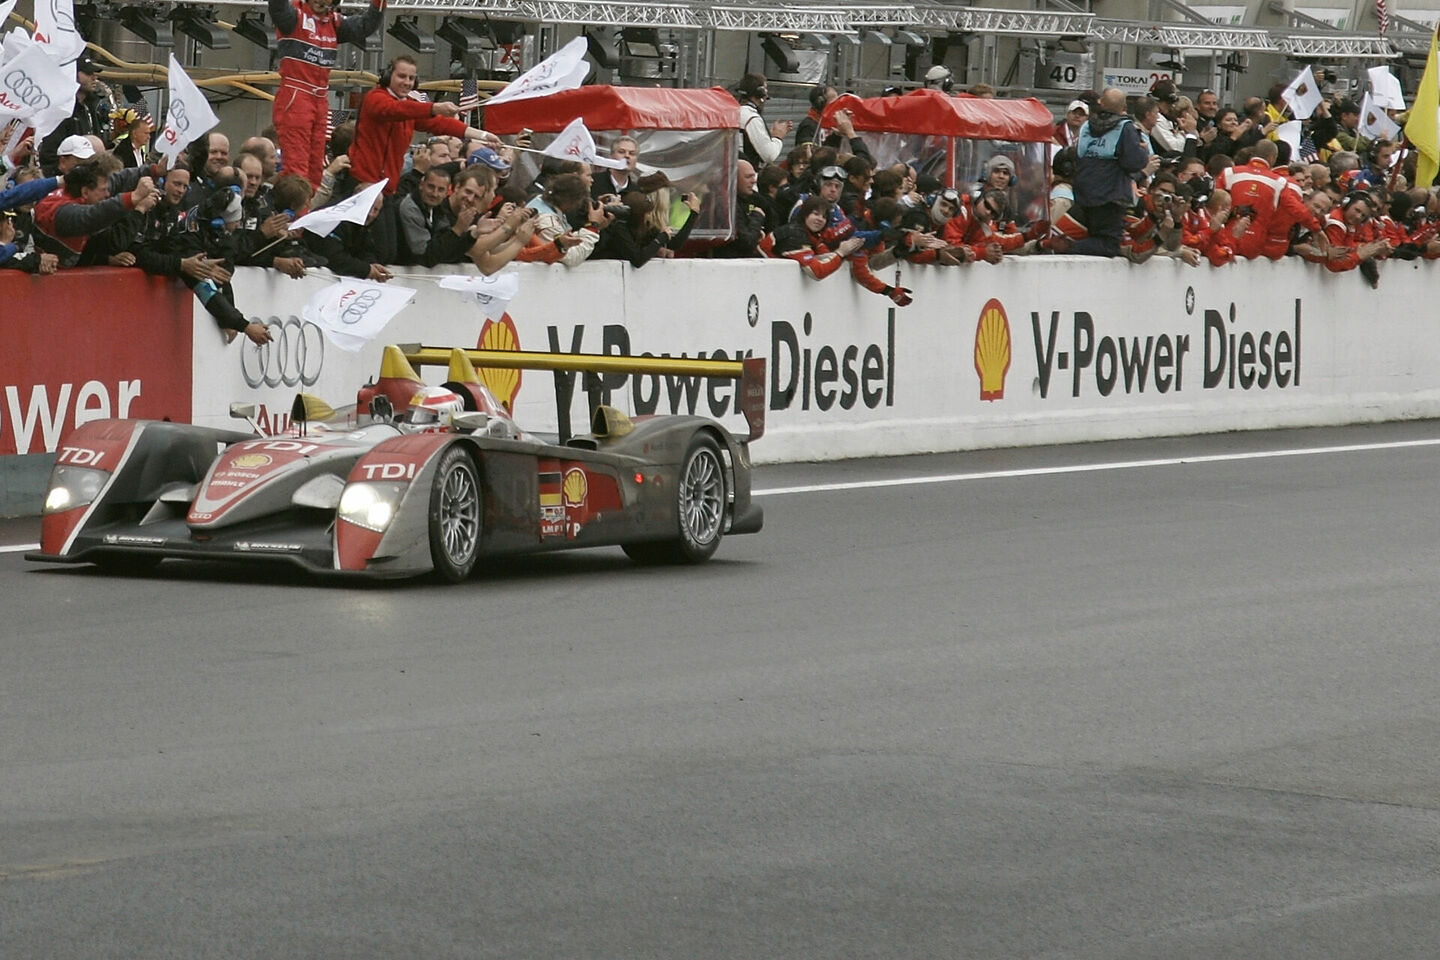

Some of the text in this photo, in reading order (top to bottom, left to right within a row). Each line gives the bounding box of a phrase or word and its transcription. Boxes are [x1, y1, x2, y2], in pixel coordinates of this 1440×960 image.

[1049, 65, 1077, 83] 40
[1116, 75, 1148, 85] TOKAI
[1030, 298, 1302, 399] V-Power Diesel
[769, 307, 896, 412] Diesel
[59, 446, 106, 466] TDI
[242, 441, 320, 455] TDI
[362, 463, 417, 479] TDI
